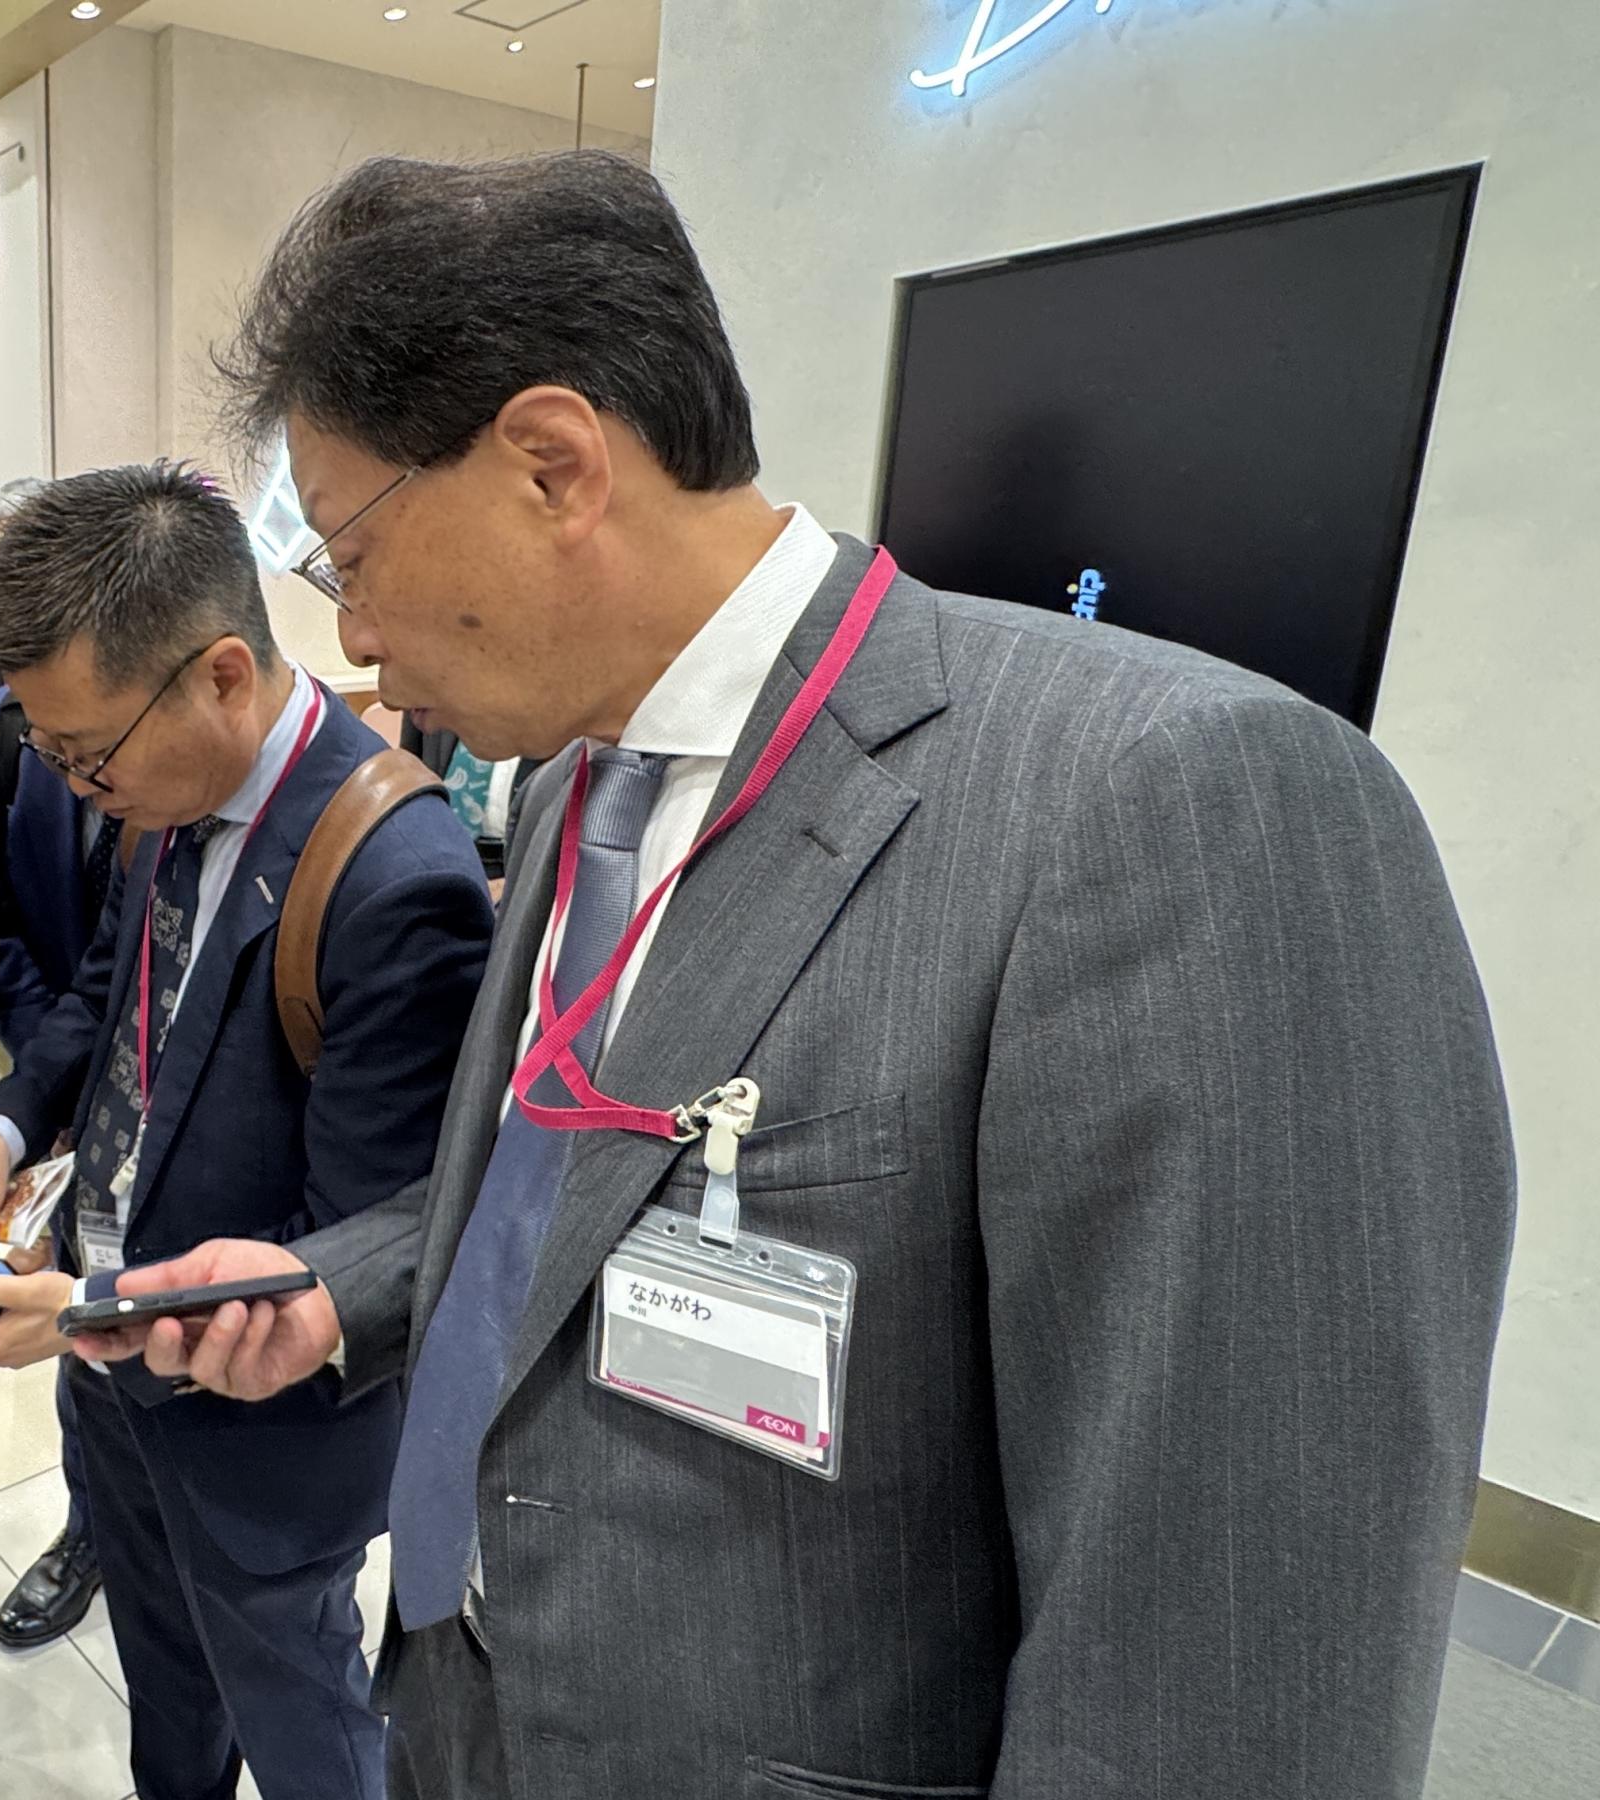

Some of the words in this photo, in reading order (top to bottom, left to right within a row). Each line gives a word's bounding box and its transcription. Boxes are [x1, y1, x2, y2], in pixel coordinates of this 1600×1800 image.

[628, 1304, 648, 1318] 中川
[629, 1281, 712, 1321] なかがわ
